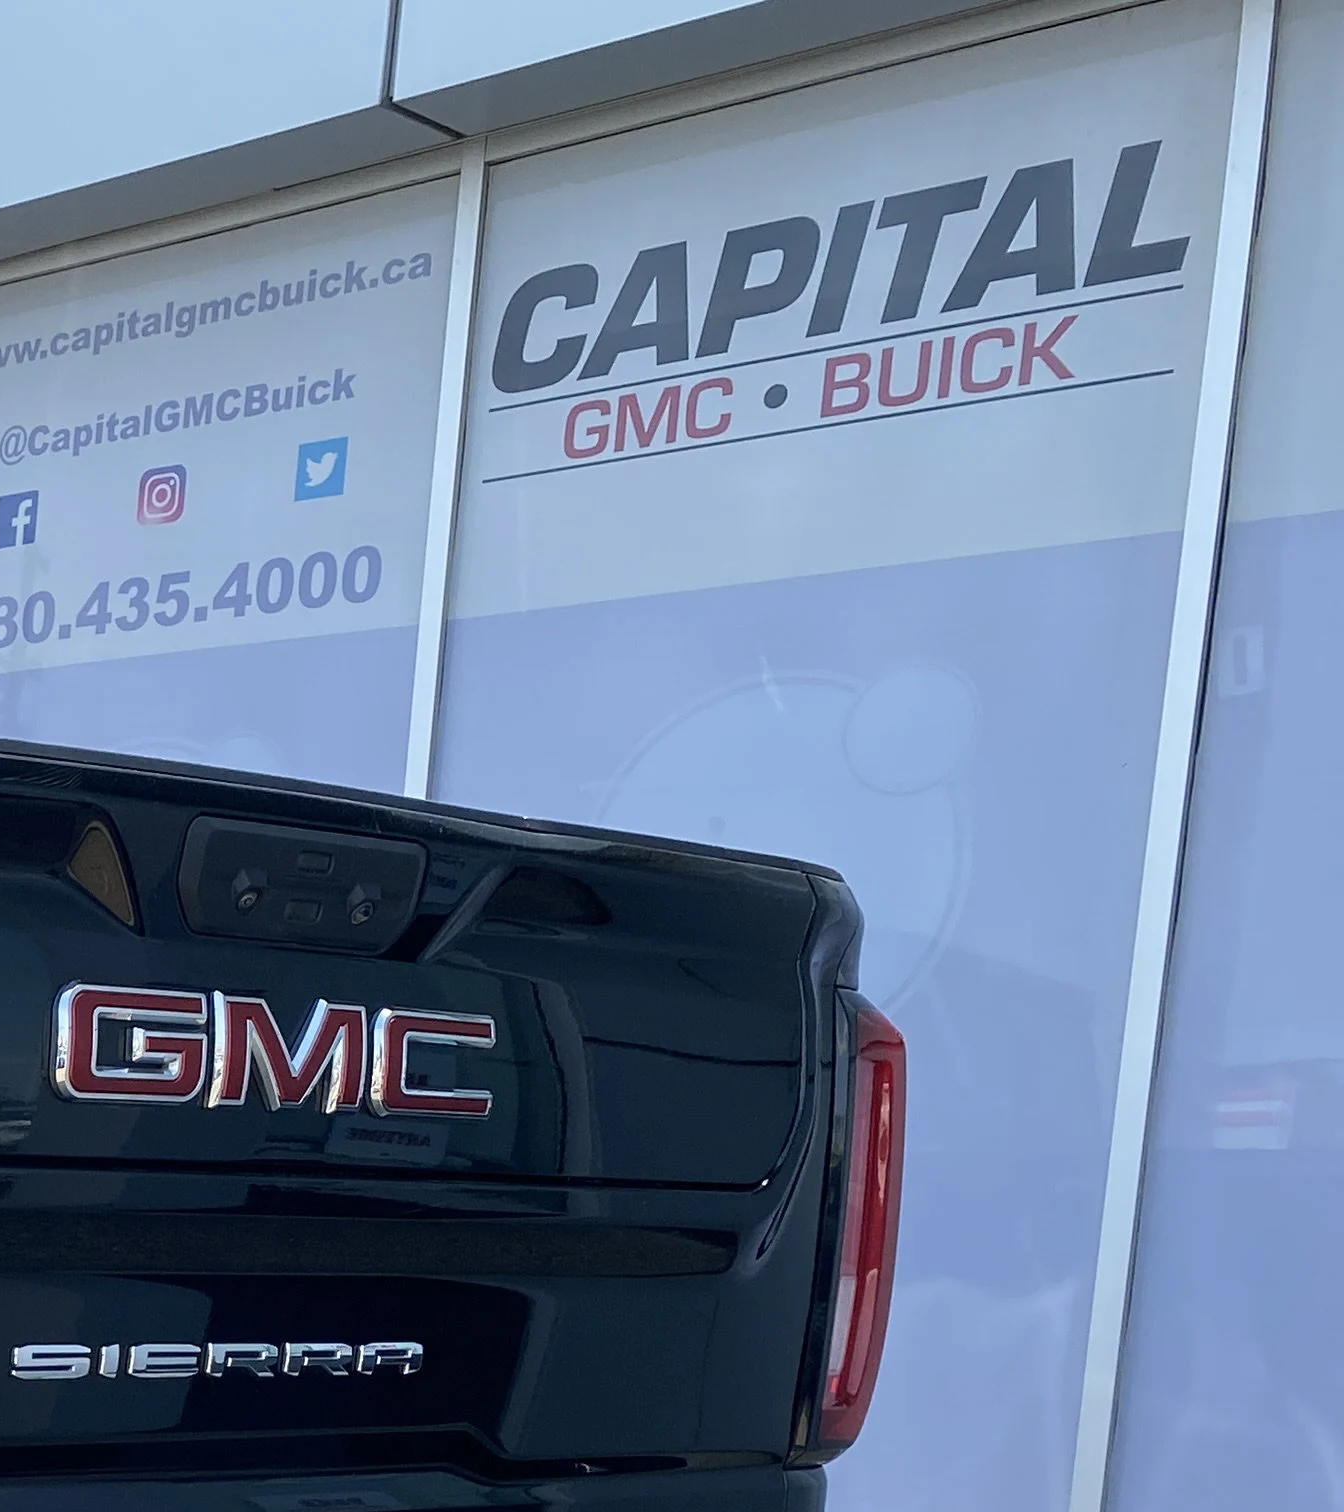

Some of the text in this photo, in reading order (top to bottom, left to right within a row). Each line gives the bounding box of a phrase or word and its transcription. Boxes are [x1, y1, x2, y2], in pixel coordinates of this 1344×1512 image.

[490, 139, 1191, 395] CAPITAL
[562, 314, 1080, 460] GMC BUICK
[52, 980, 496, 1119] GMC
[9, 1340, 425, 1381] SIERRA
